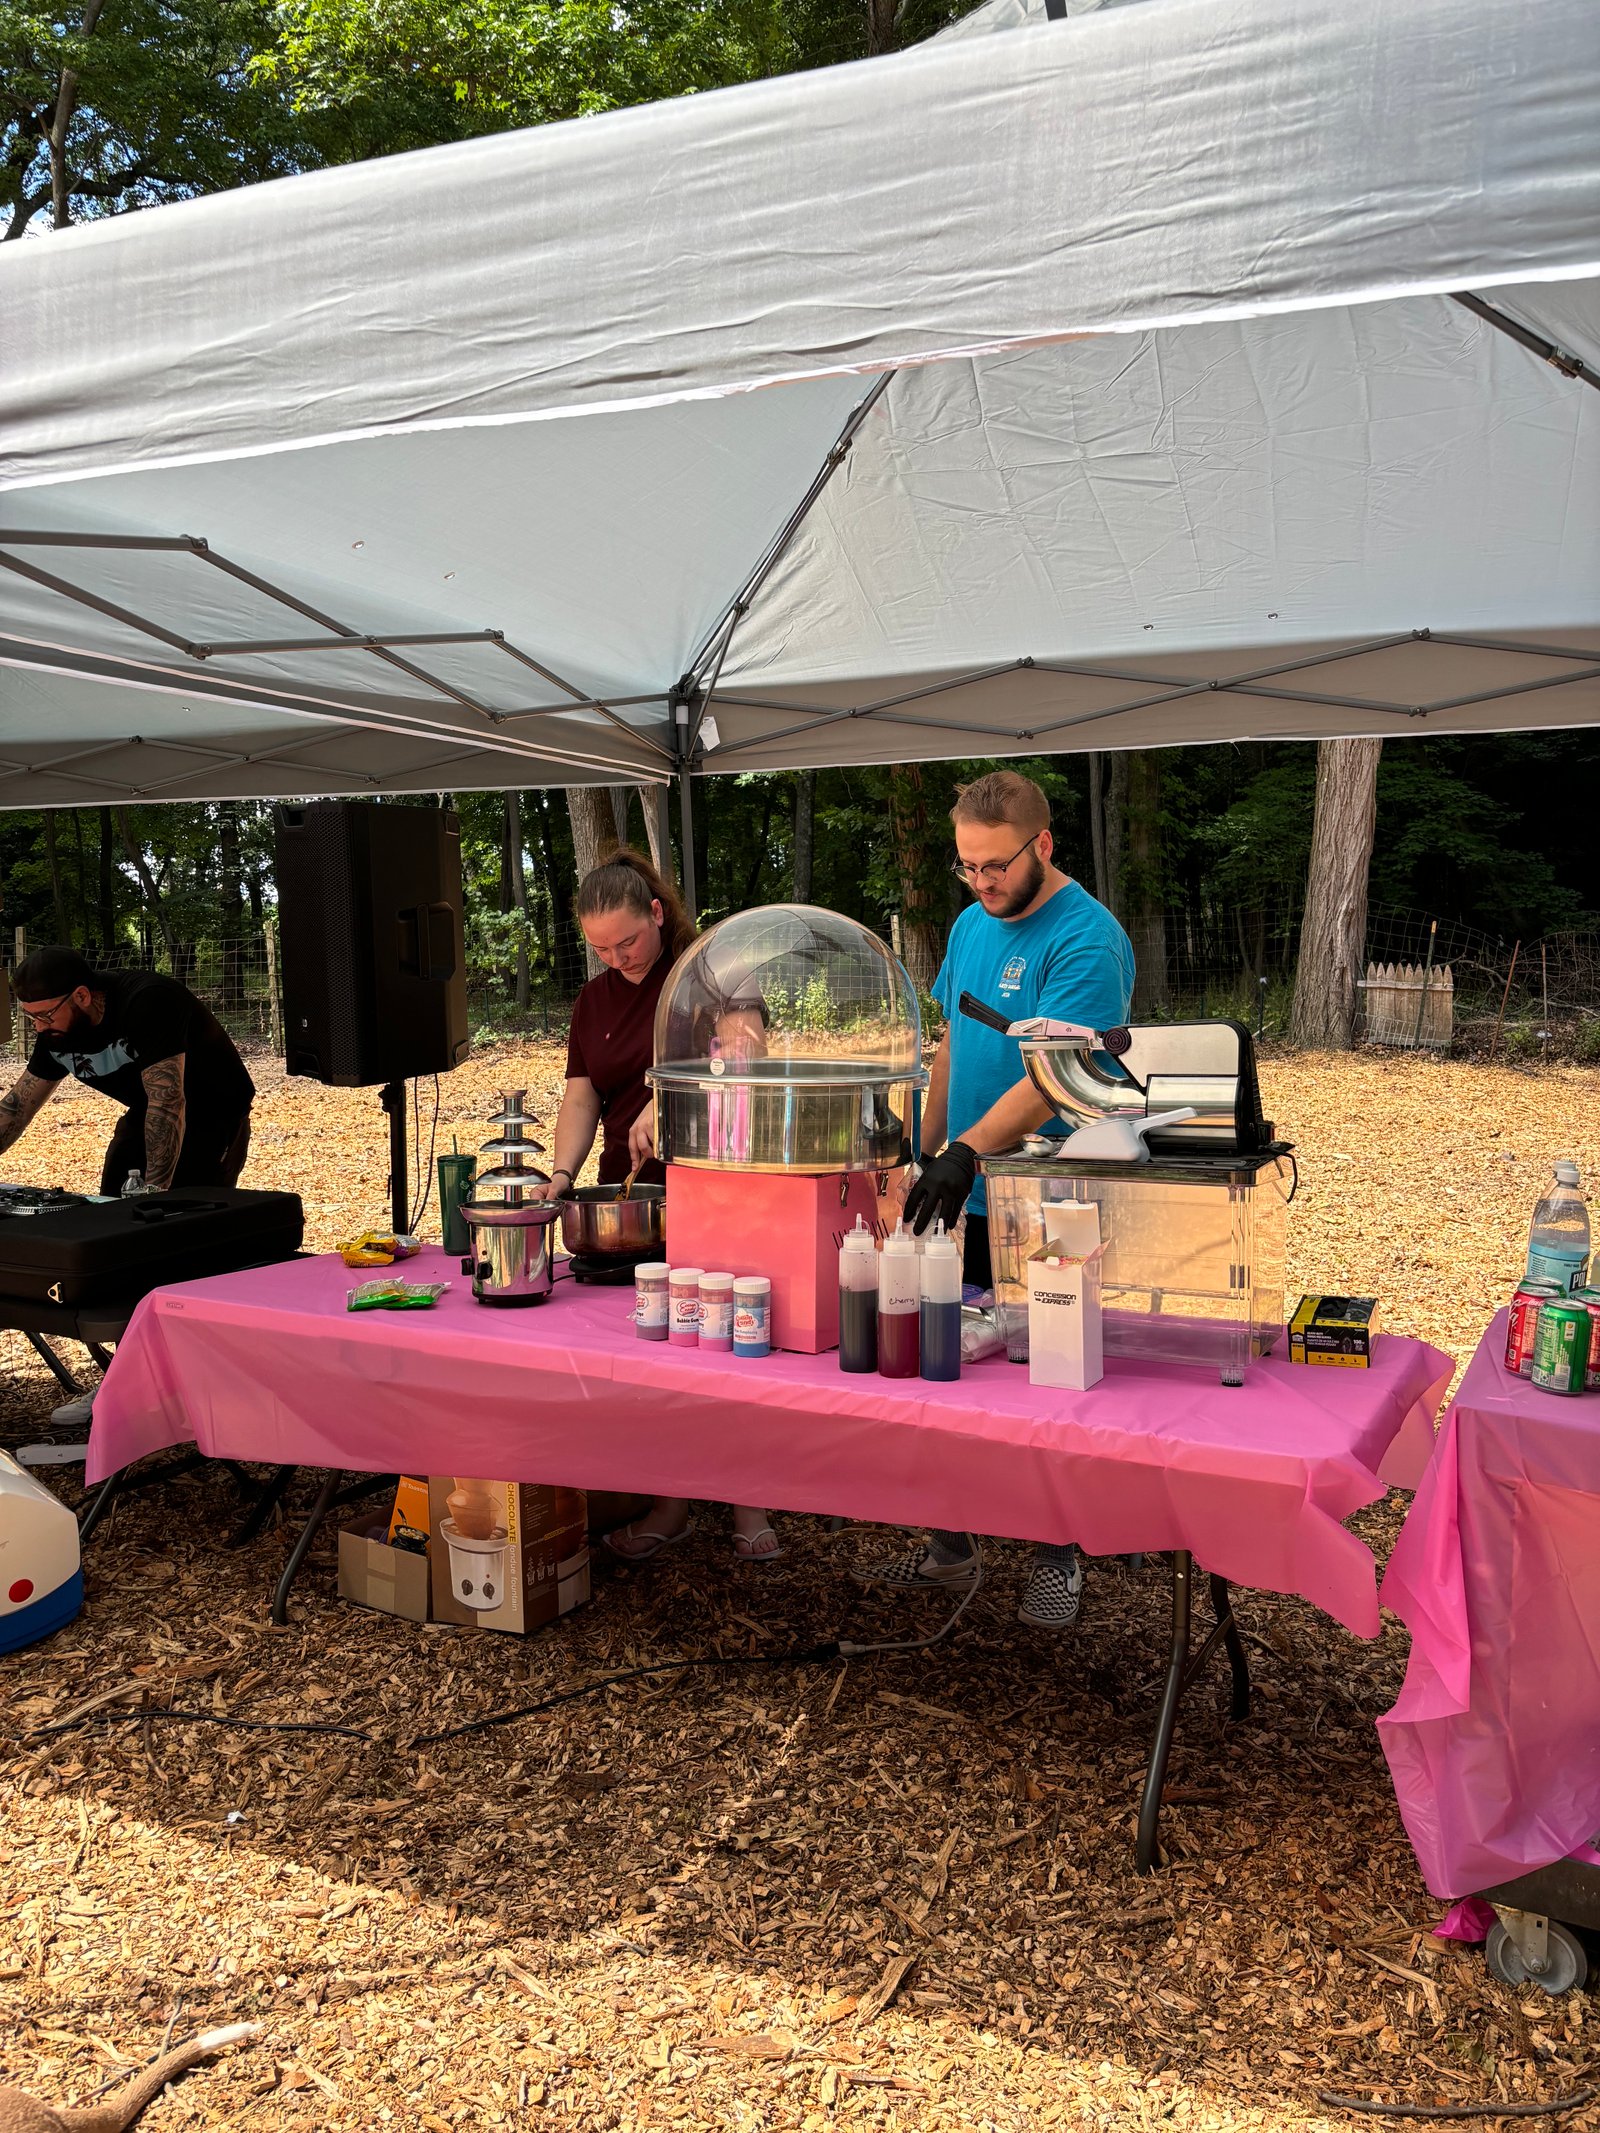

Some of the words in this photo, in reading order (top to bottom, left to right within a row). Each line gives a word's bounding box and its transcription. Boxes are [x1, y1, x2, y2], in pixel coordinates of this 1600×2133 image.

[1033, 1291, 1077, 1300] CONCESSION
[507, 1483, 517, 1543] CHOCOLATE
[509, 1544, 518, 1574] fondue
[511, 1576, 519, 1612] fountain
